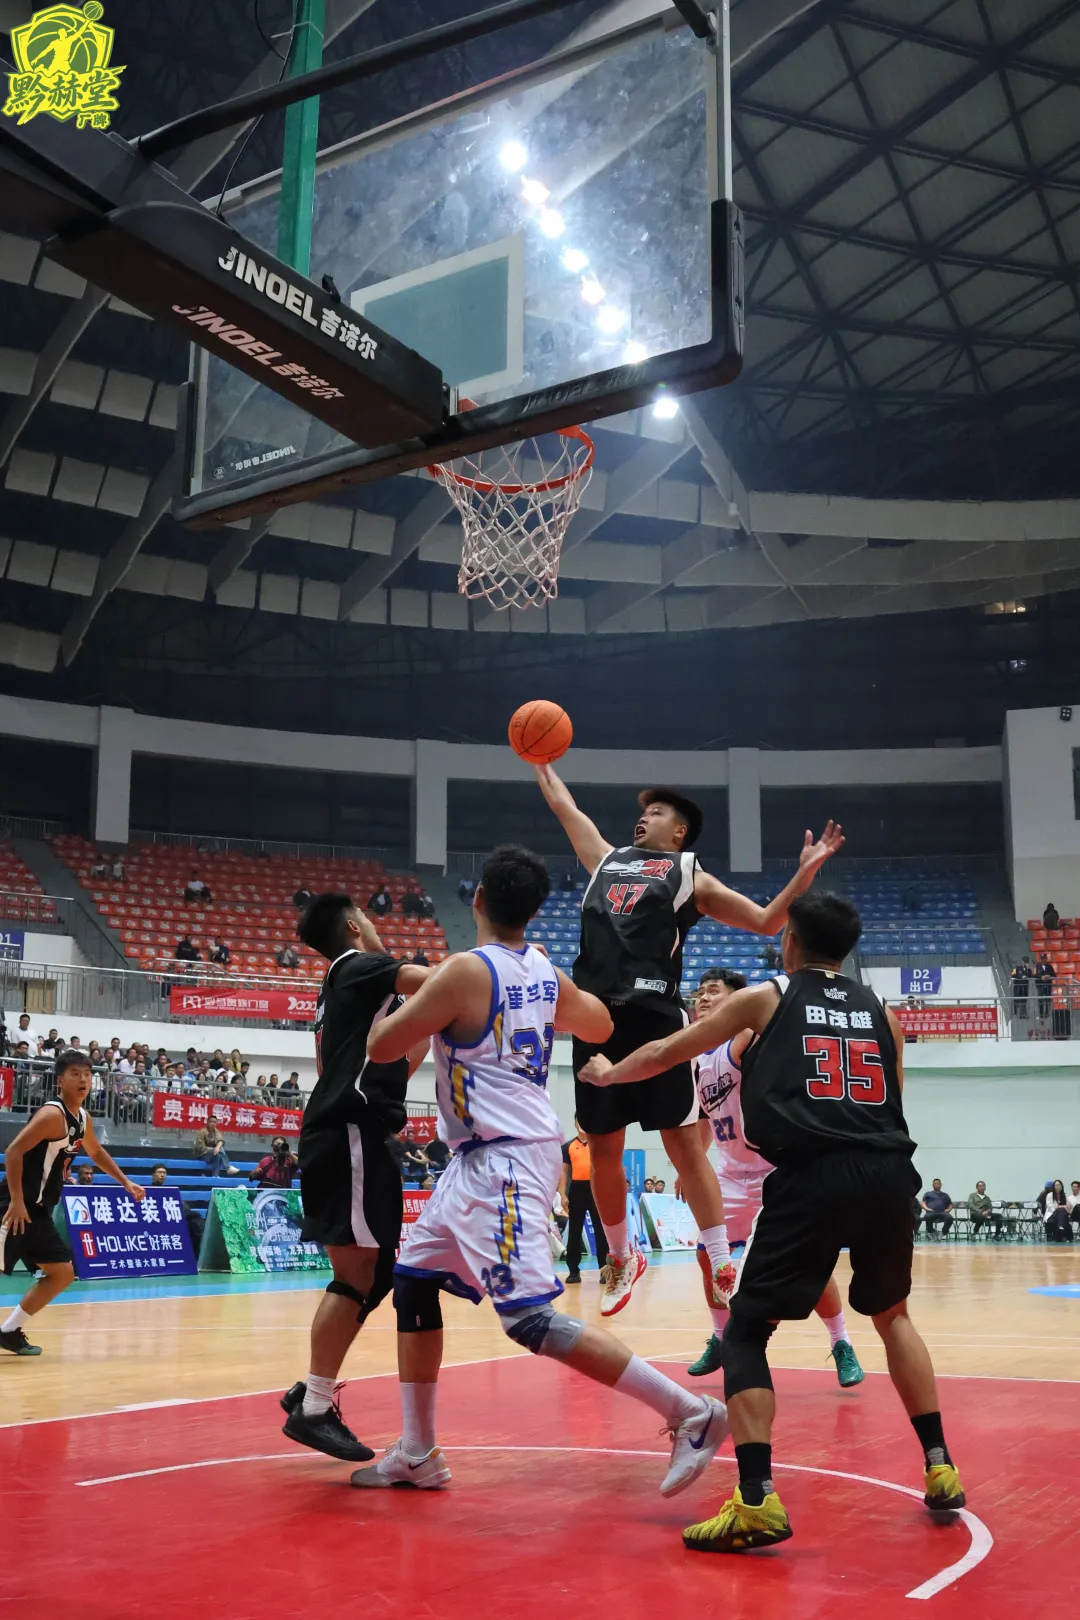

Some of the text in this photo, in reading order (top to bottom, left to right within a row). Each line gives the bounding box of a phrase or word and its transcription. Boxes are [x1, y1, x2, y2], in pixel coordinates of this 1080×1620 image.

[218, 246, 378, 360] JINOEL 吉诺尔
[172, 304, 345, 399] JINOEL 吉诺尔
[606, 883, 649, 915] 47
[909, 981, 933, 993] 出口
[913, 969, 930, 979] D2
[805, 1005, 873, 1029] 田茂雄
[802, 1034, 887, 1106] 35
[713, 1115, 738, 1142] 27
[91, 1195, 182, 1225] 雄达装饰
[148, 1234, 183, 1251] 好莱客
